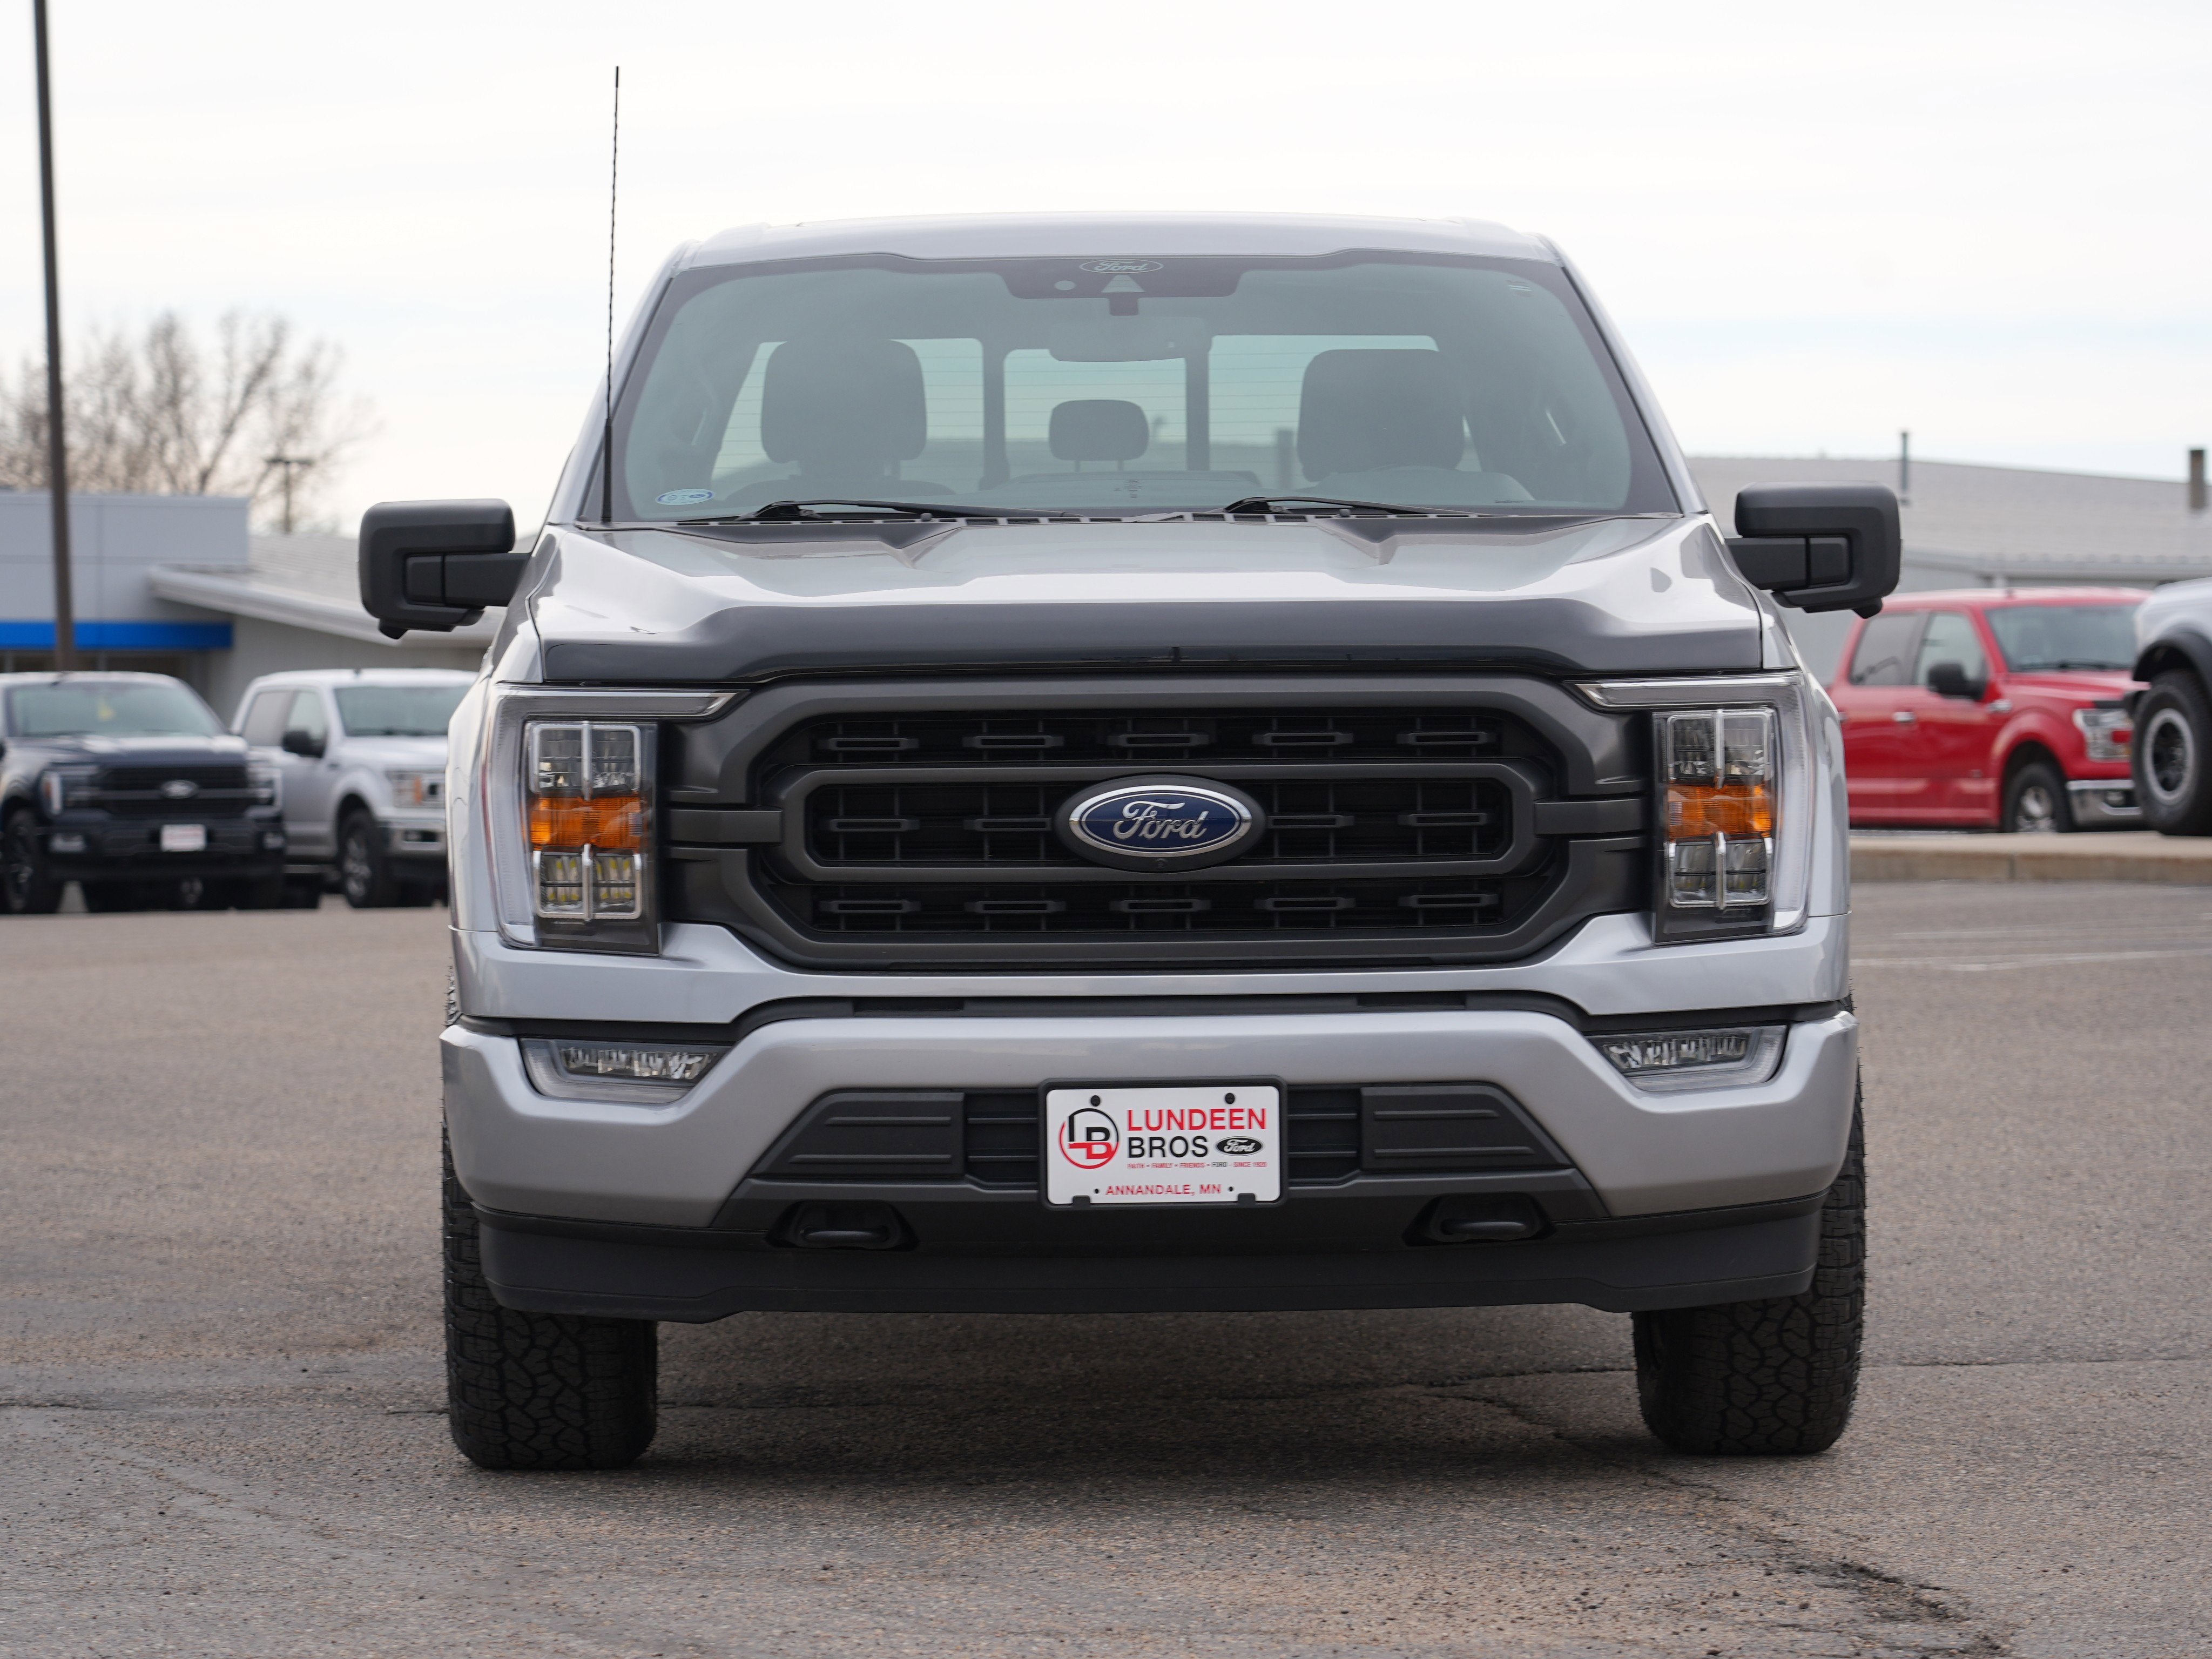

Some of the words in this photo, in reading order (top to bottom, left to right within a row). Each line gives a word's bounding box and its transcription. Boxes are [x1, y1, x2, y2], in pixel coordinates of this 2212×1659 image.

[1094, 260, 1149, 271] Ford
[1112, 801, 1209, 839] Ford
[1127, 1108, 1266, 1131] LUNDEEN
[1128, 1135, 1209, 1158] BROS
[1223, 1139, 1256, 1152] Ford
[1105, 1184, 1195, 1196] ANNANDALE,
[1199, 1184, 1222, 1194] MN
